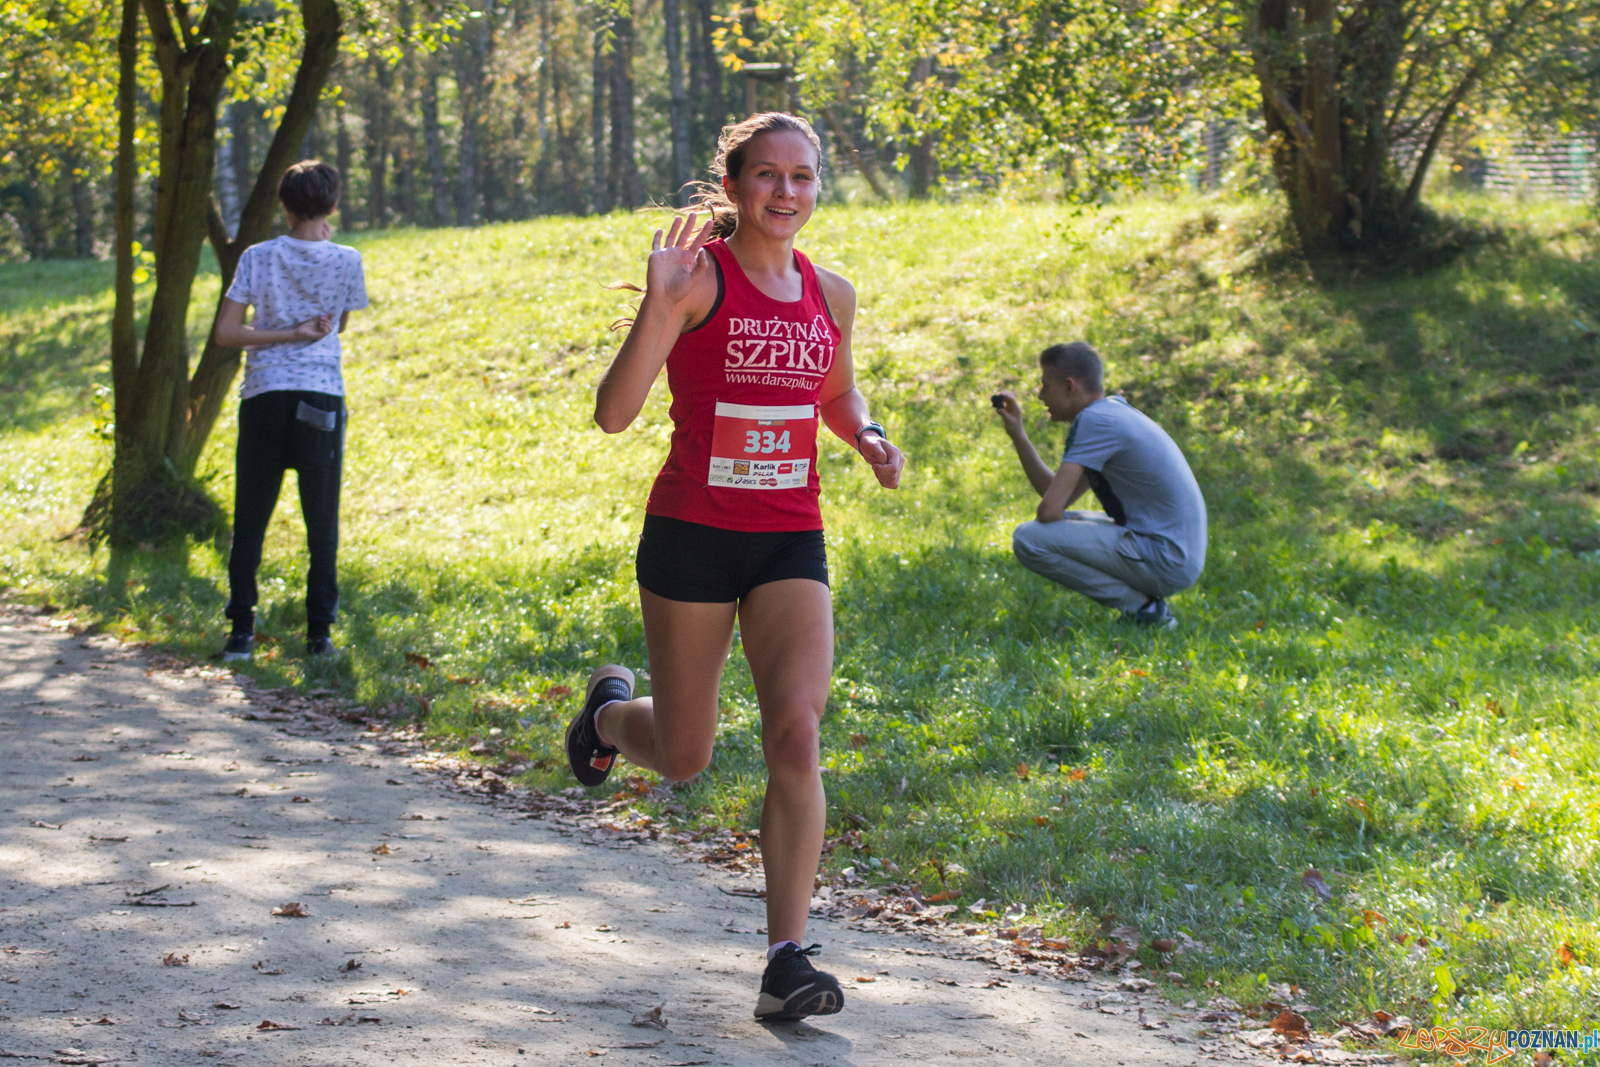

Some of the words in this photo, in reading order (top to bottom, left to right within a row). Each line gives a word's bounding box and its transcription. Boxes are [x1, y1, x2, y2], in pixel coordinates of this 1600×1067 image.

[728, 316, 820, 342] DRUŻYNA
[725, 339, 834, 373] SZPIKU
[743, 429, 791, 454] 334
